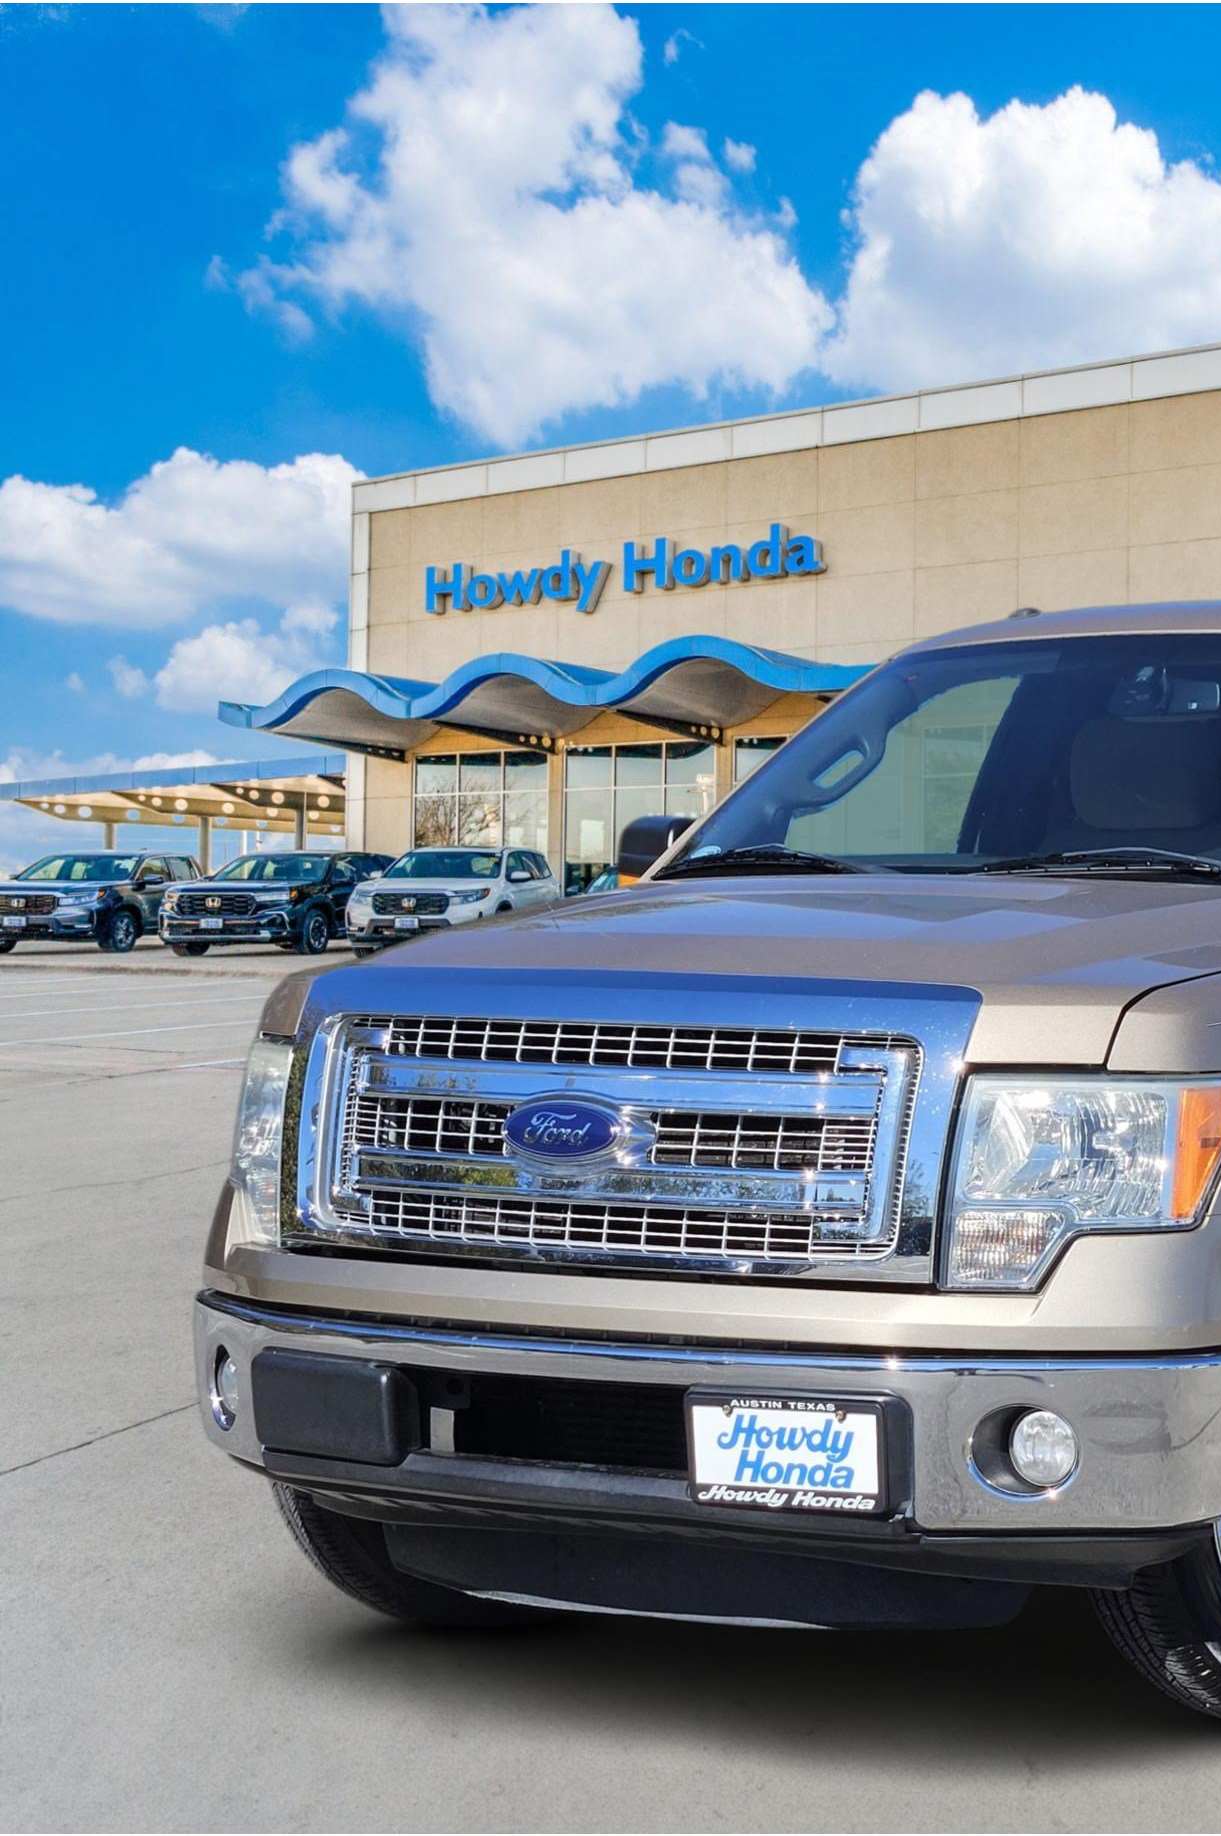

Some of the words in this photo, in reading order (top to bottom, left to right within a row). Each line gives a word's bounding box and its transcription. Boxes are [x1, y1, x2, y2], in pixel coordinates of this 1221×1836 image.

[424, 548, 612, 615] Howdy
[623, 523, 828, 594] Honda
[523, 1111, 592, 1146] Ford
[730, 1399, 783, 1410] AUSTIN
[787, 1401, 836, 1412] TEXAS
[717, 1414, 854, 1463] Howdy
[734, 1450, 855, 1489] Honda
[698, 1485, 788, 1507] Howdy
[791, 1492, 876, 1510] Honda
